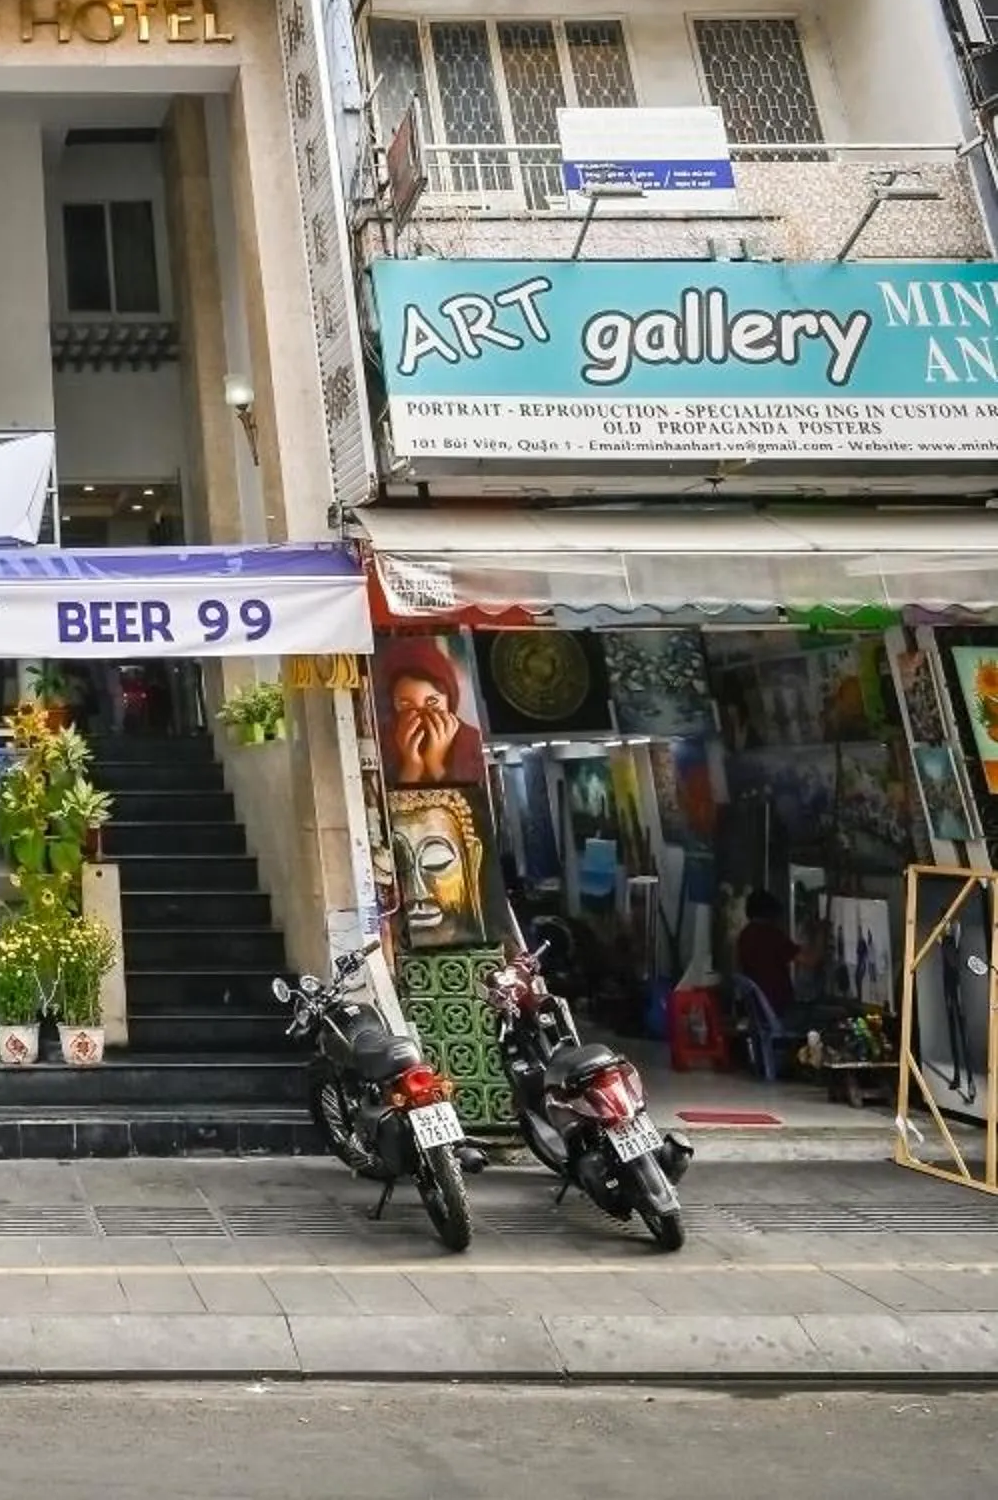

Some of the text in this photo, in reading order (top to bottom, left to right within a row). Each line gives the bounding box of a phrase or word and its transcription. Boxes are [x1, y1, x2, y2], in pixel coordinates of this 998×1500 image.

[396, 276, 553, 376] ART
[581, 287, 871, 386] gallery
[407, 403, 501, 417] PORTRAIT
[520, 404, 669, 418] REPRODUCTION
[685, 404, 819, 419] SPECIALIZING
[825, 404, 859, 419] ING
[865, 404, 885, 419] IN
[891, 404, 969, 419] CUSTOM
[604, 421, 882, 436] OLD PROPAGANDA POSTERS
[411, 438, 437, 450] 101
[565, 439, 572, 450] 1
[848, 439, 913, 452] Website:
[58, 600, 174, 644] BEER
